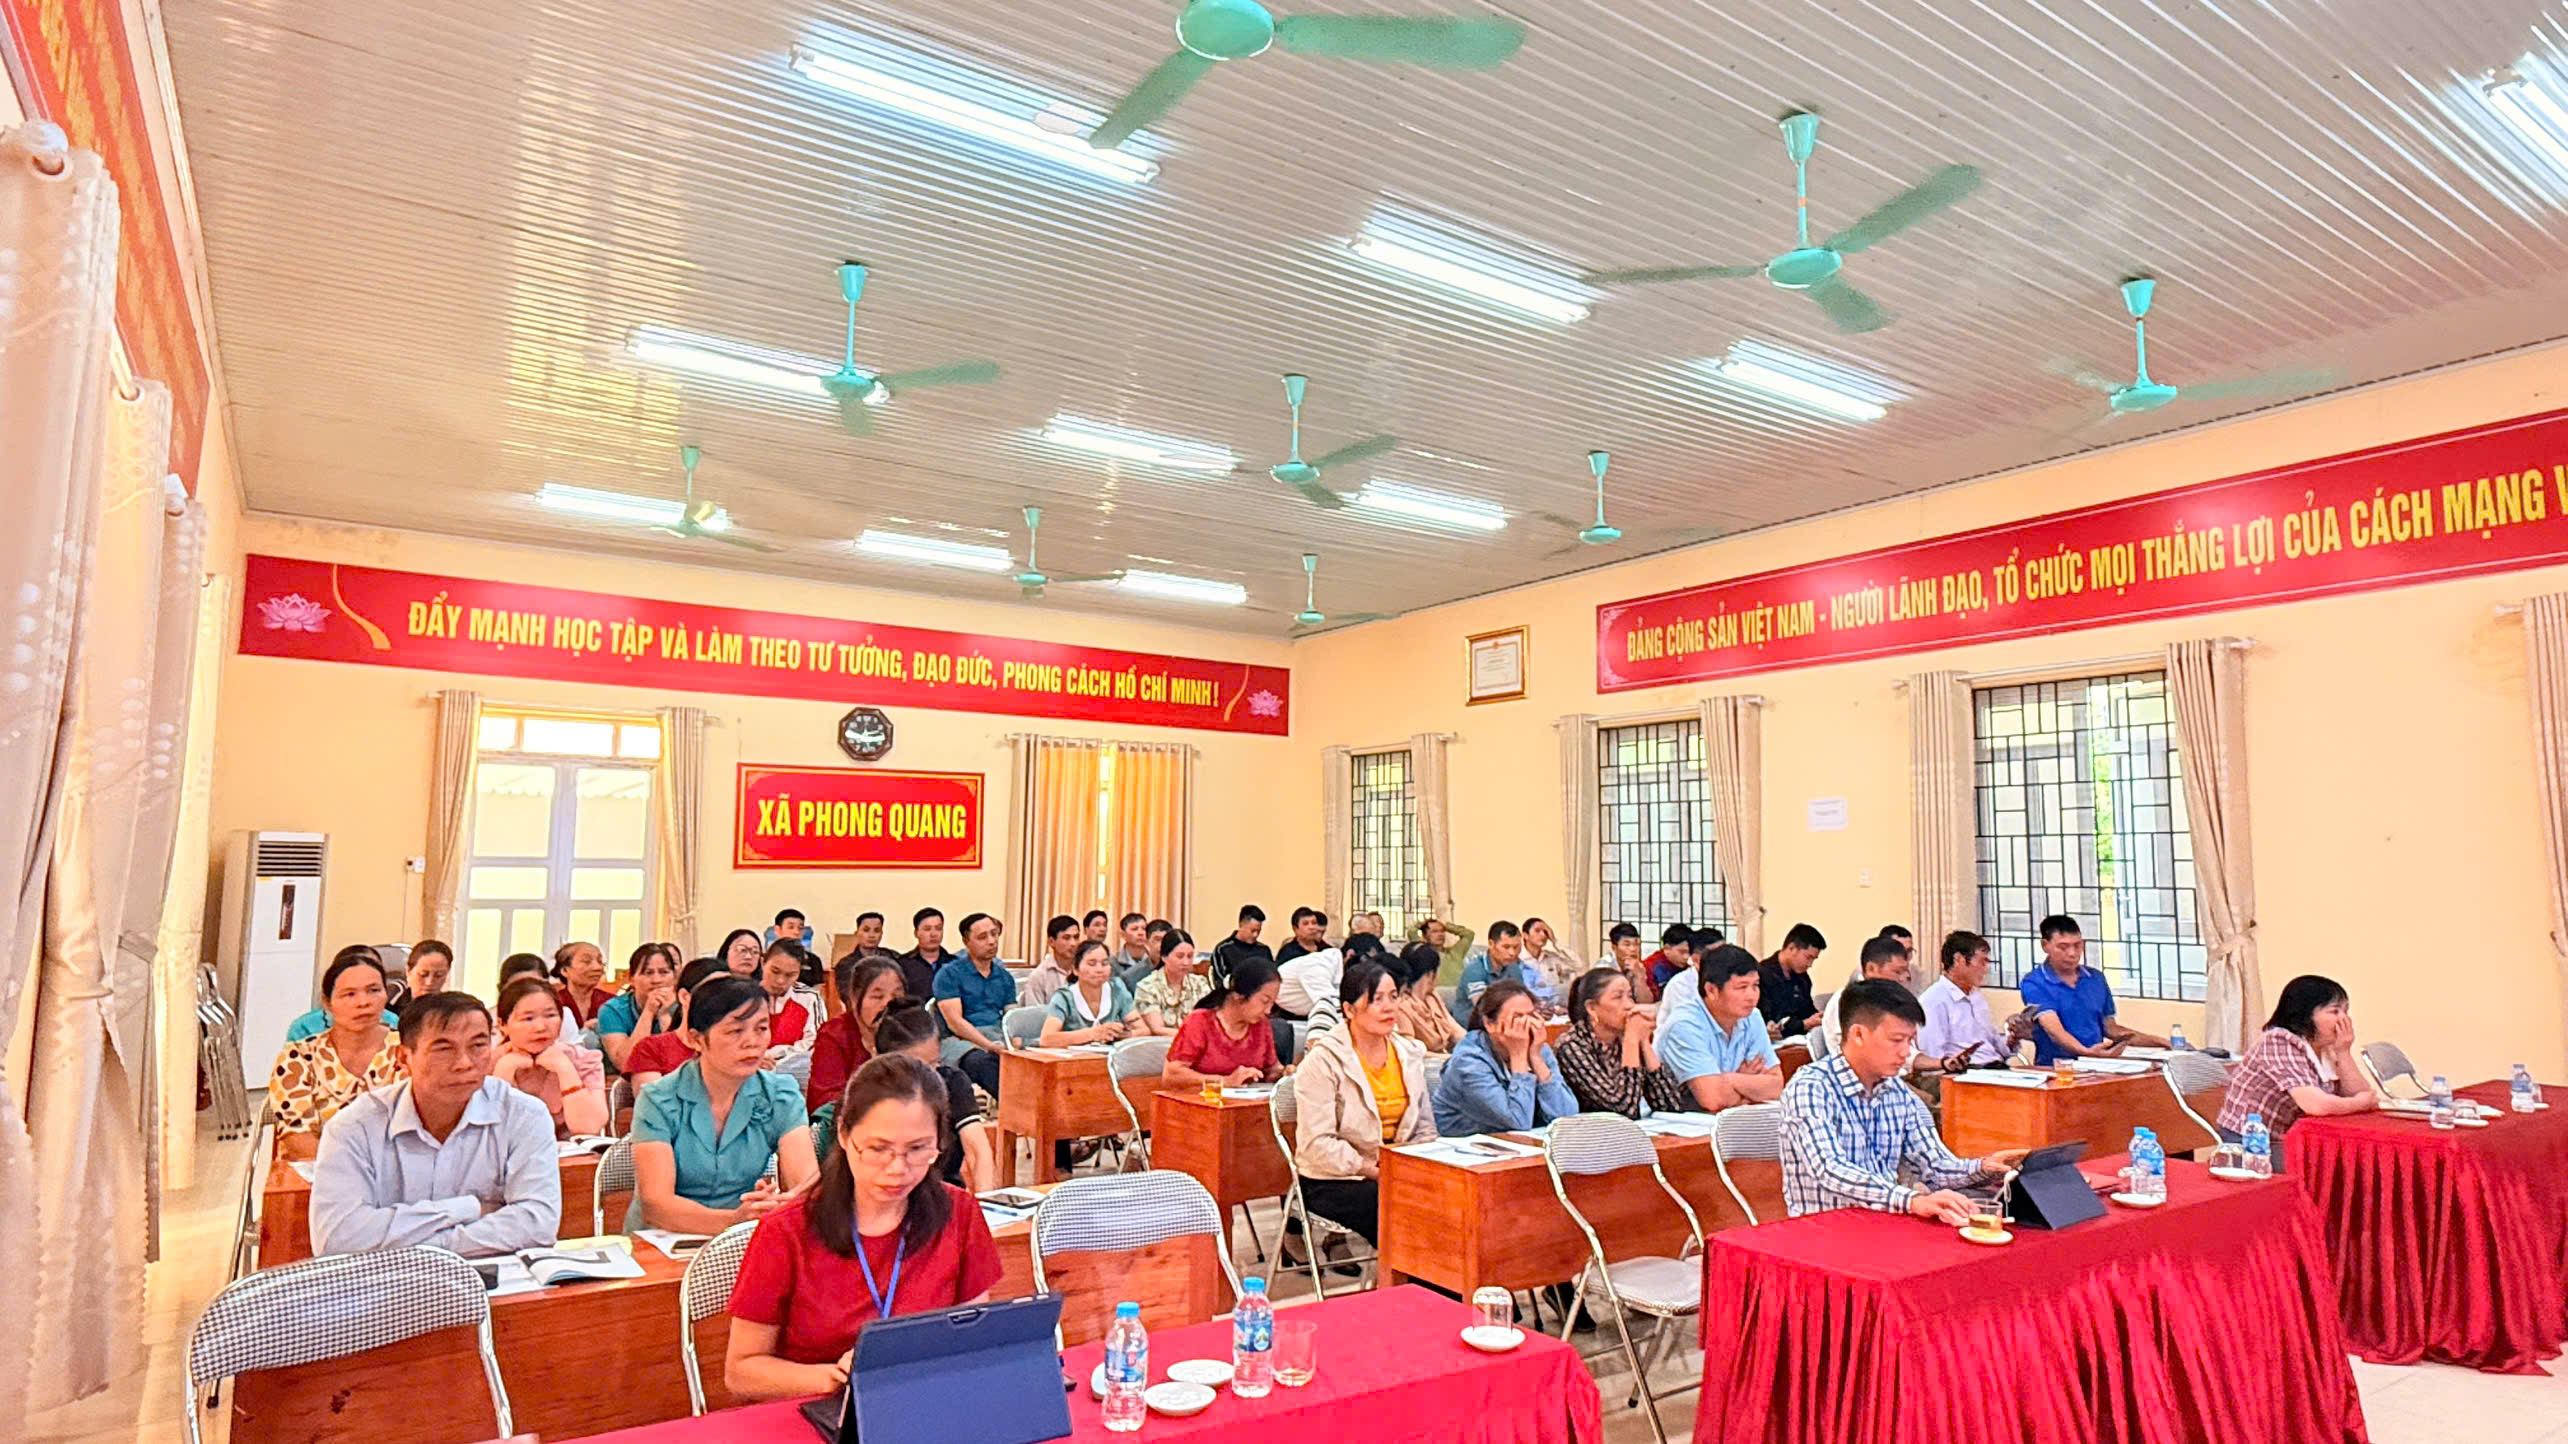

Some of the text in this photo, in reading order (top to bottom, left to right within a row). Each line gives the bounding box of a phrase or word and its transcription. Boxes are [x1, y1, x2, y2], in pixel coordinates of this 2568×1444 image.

[1666, 616, 1704, 662] CỘNG
[1708, 601, 1738, 650] SẢN
[1741, 601, 1773, 650] VIỆT
[1777, 600, 1815, 639] NAM
[1831, 579, 1884, 631] NGƯỜI
[1889, 576, 1938, 621] LÃNH
[1942, 569, 1989, 619] ĐẠO,
[1993, 547, 2020, 605] TỔ
[2025, 543, 2084, 600] CHỨC
[2090, 542, 2136, 596] MỌI
[2142, 517, 2225, 582] THẮNG
[2233, 514, 2276, 575] LỢI
[2284, 490, 2342, 559] CỦA
[2349, 486, 2433, 547] CÁCH
[2443, 470, 2546, 540] MẠNG
[408, 591, 462, 638] ĐẨY
[469, 608, 545, 651] MẠNH
[553, 617, 602, 656] HỌC
[610, 617, 653, 661] TẬP
[661, 622, 689, 660] VÀ
[695, 626, 742, 664] LÀM
[749, 636, 801, 670] THEO
[808, 640, 835, 672] TƯ
[838, 634, 908, 683] TƯỞNG,
[913, 651, 951, 688] ĐẠO
[956, 649, 997, 691] ĐỨC,
[1003, 661, 1062, 693] PHONG
[1066, 663, 1111, 697] CÁCH
[1115, 664, 1137, 699] HỒ
[1140, 671, 1168, 702] CHÍ
[756, 793, 967, 841] XÃ PHONG QUANG
